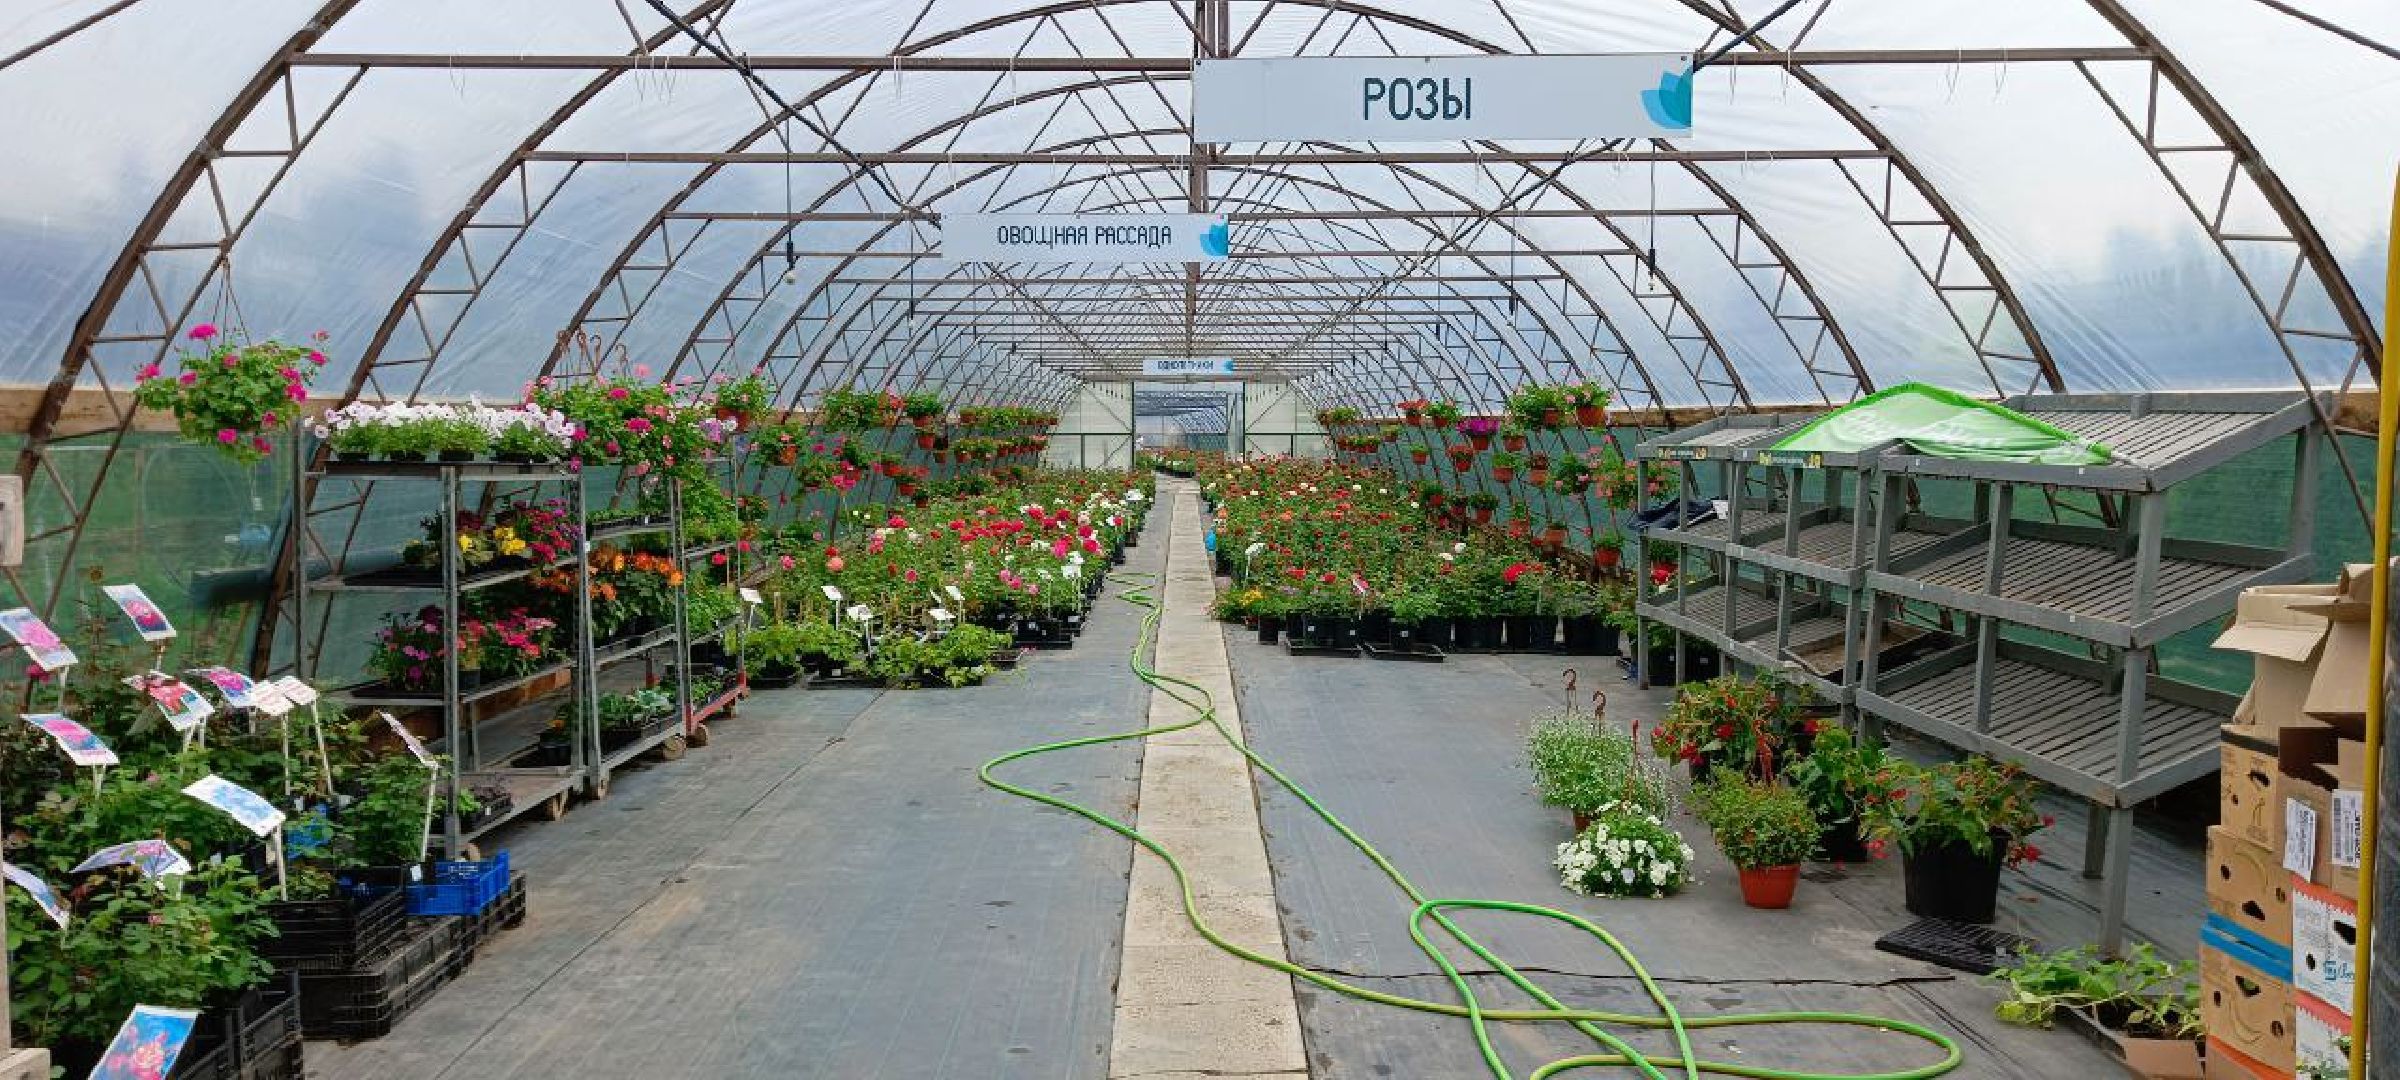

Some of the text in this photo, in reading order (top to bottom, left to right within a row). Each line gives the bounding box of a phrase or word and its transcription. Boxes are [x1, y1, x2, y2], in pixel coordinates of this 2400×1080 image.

[1363, 77, 1472, 121] РОЗЫ
[997, 225, 1172, 249] ОВОЩНАЯ РАССАДА
